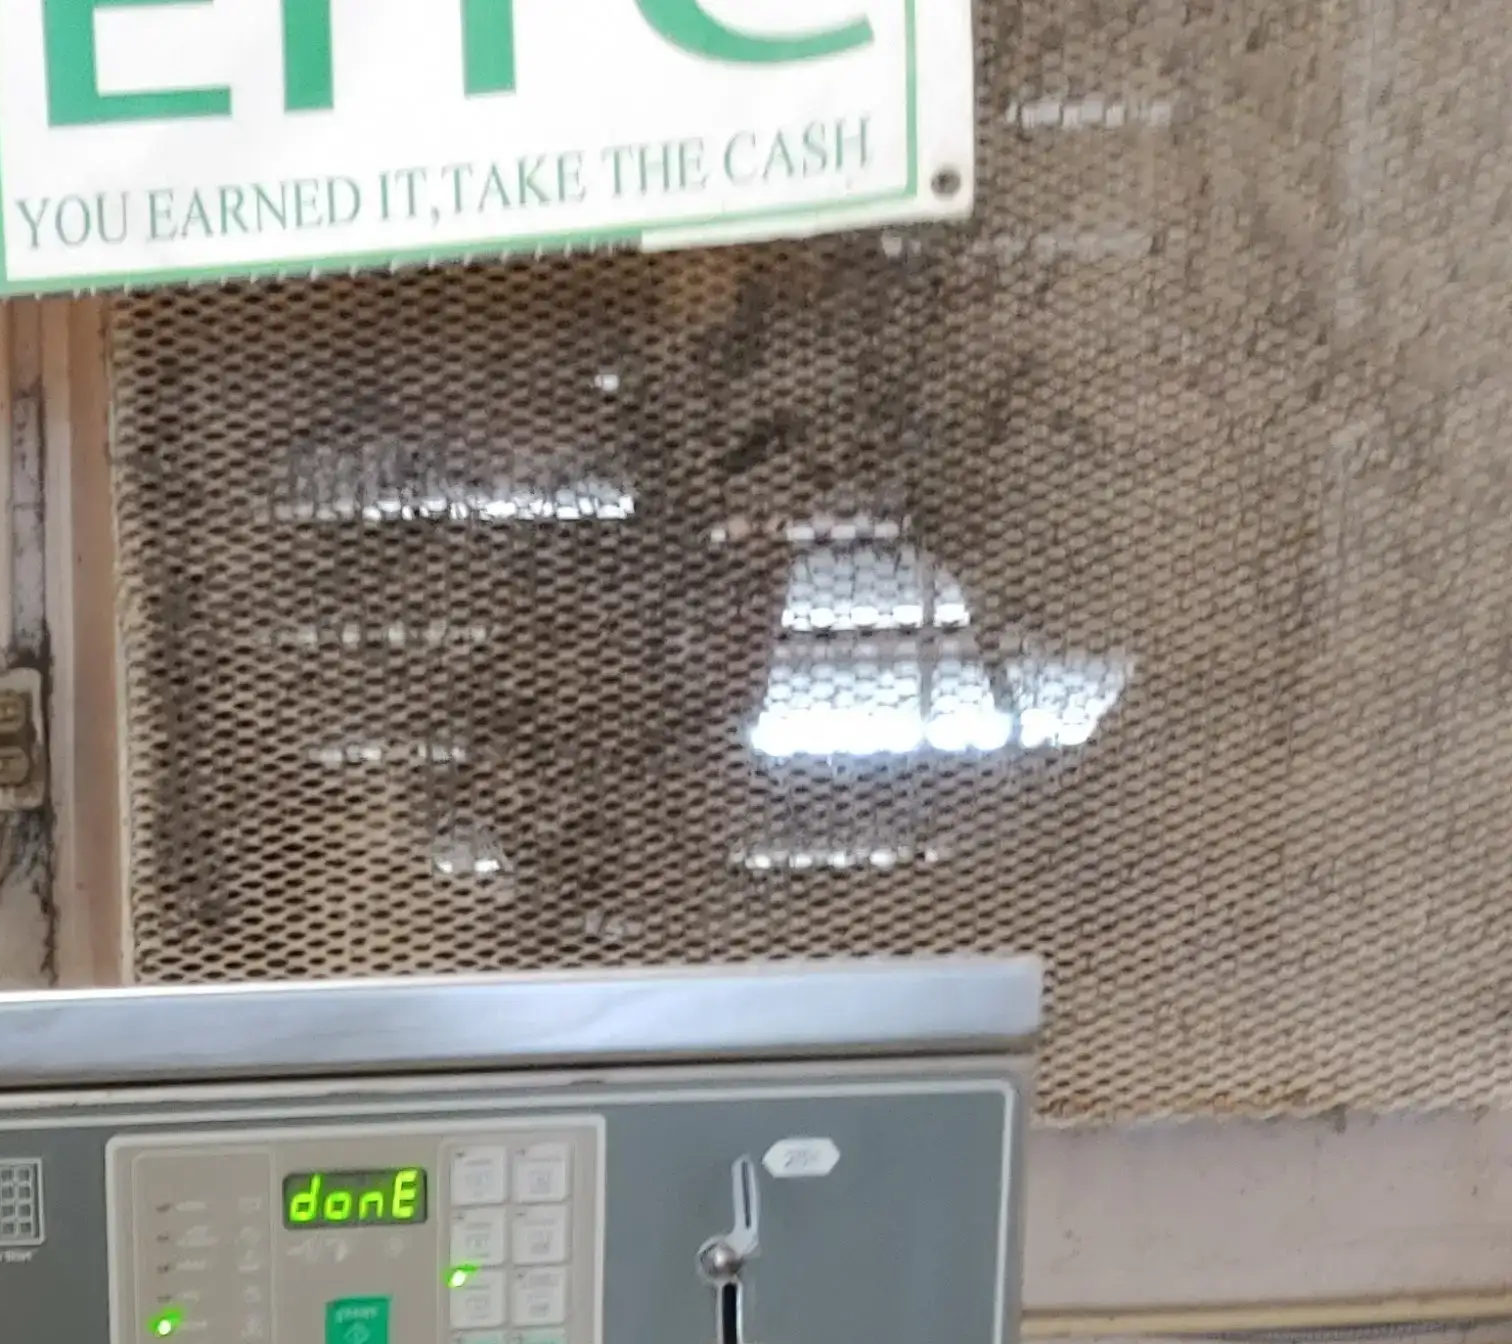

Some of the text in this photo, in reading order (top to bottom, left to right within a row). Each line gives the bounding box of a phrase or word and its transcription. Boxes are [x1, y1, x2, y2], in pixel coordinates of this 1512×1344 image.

[16, 189, 129, 250] YOU
[147, 175, 362, 241] EARNED
[600, 136, 710, 199] THE
[722, 114, 873, 185] CASH
